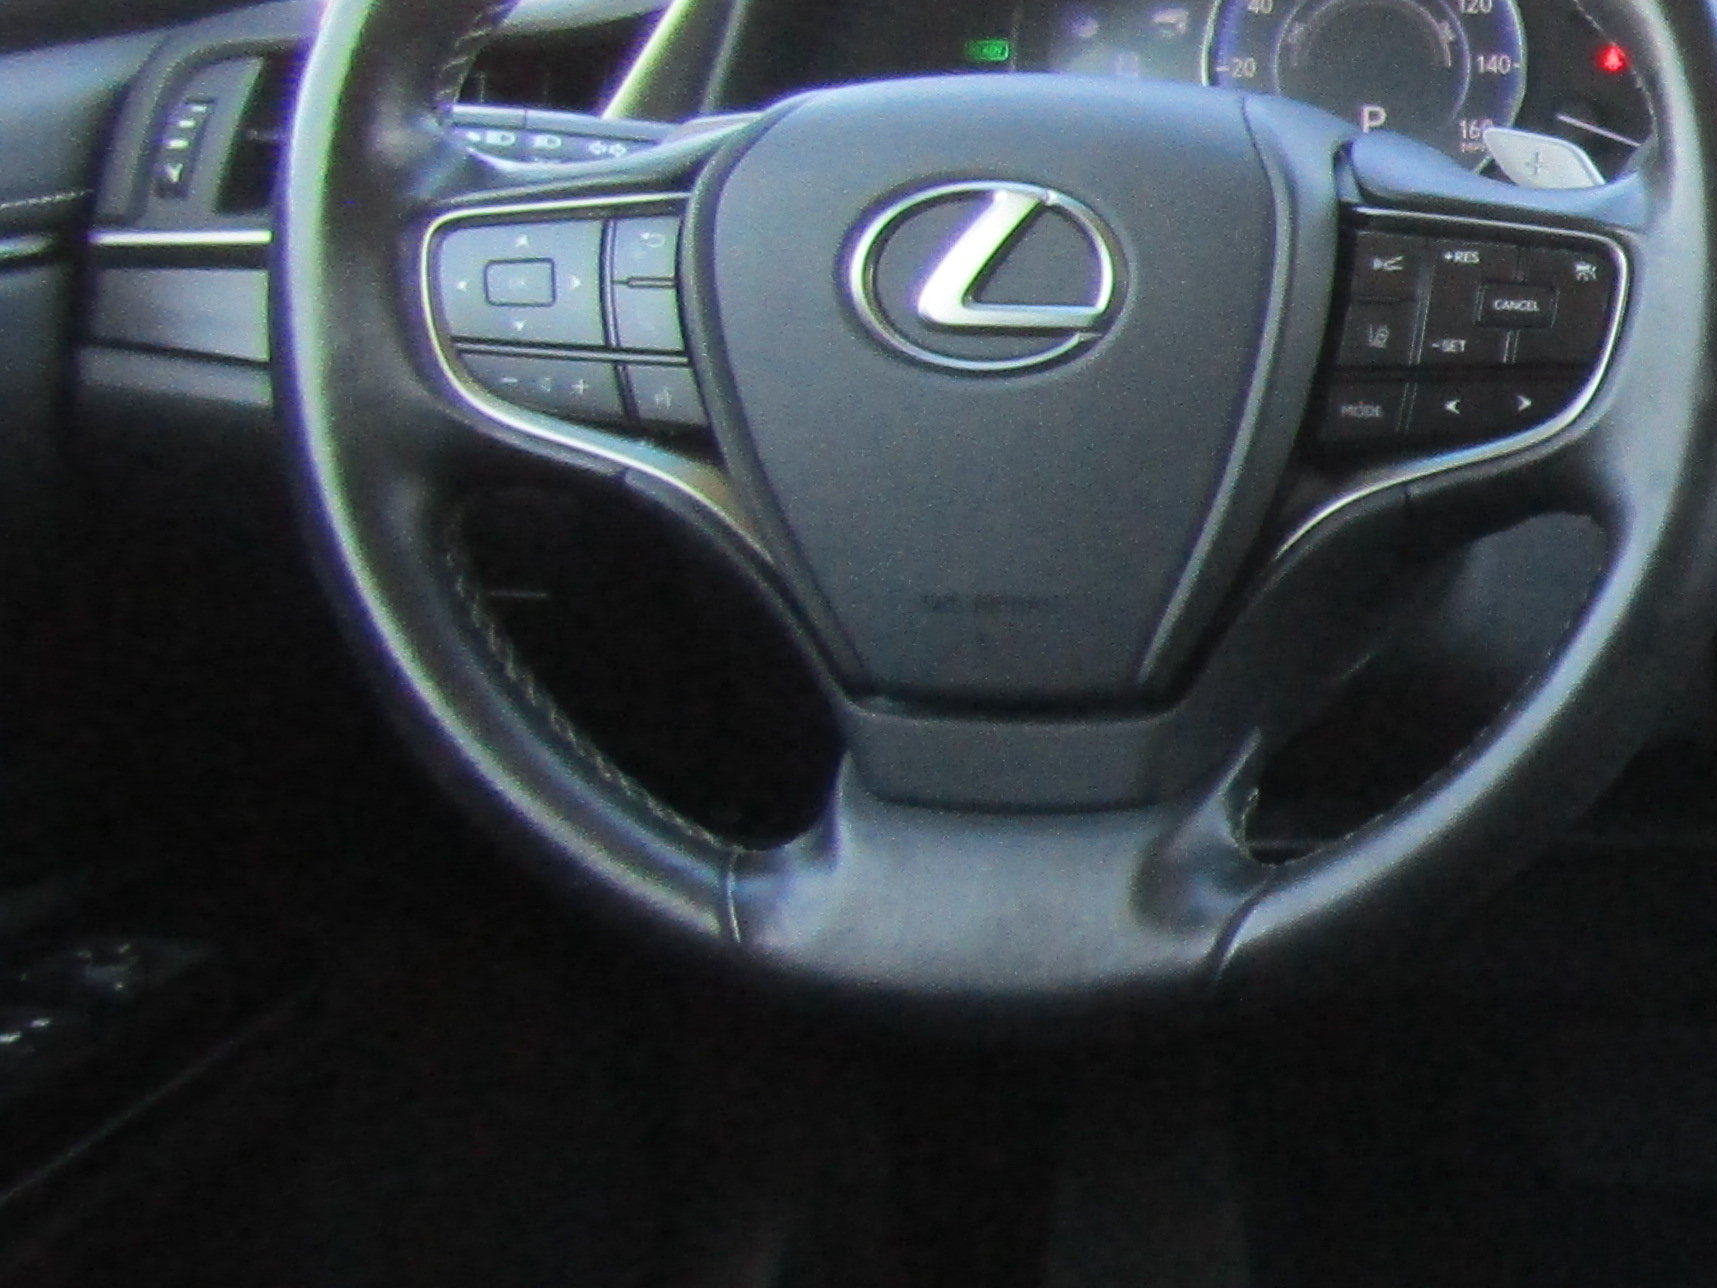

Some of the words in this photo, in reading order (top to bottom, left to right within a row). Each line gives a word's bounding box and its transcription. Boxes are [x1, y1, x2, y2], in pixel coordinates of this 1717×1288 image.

[1231, 57, 1256, 78] 20
[1478, 55, 1512, 74] 140
[1361, 105, 1387, 134] P
[1494, 299, 1540, 312] CANCEL
